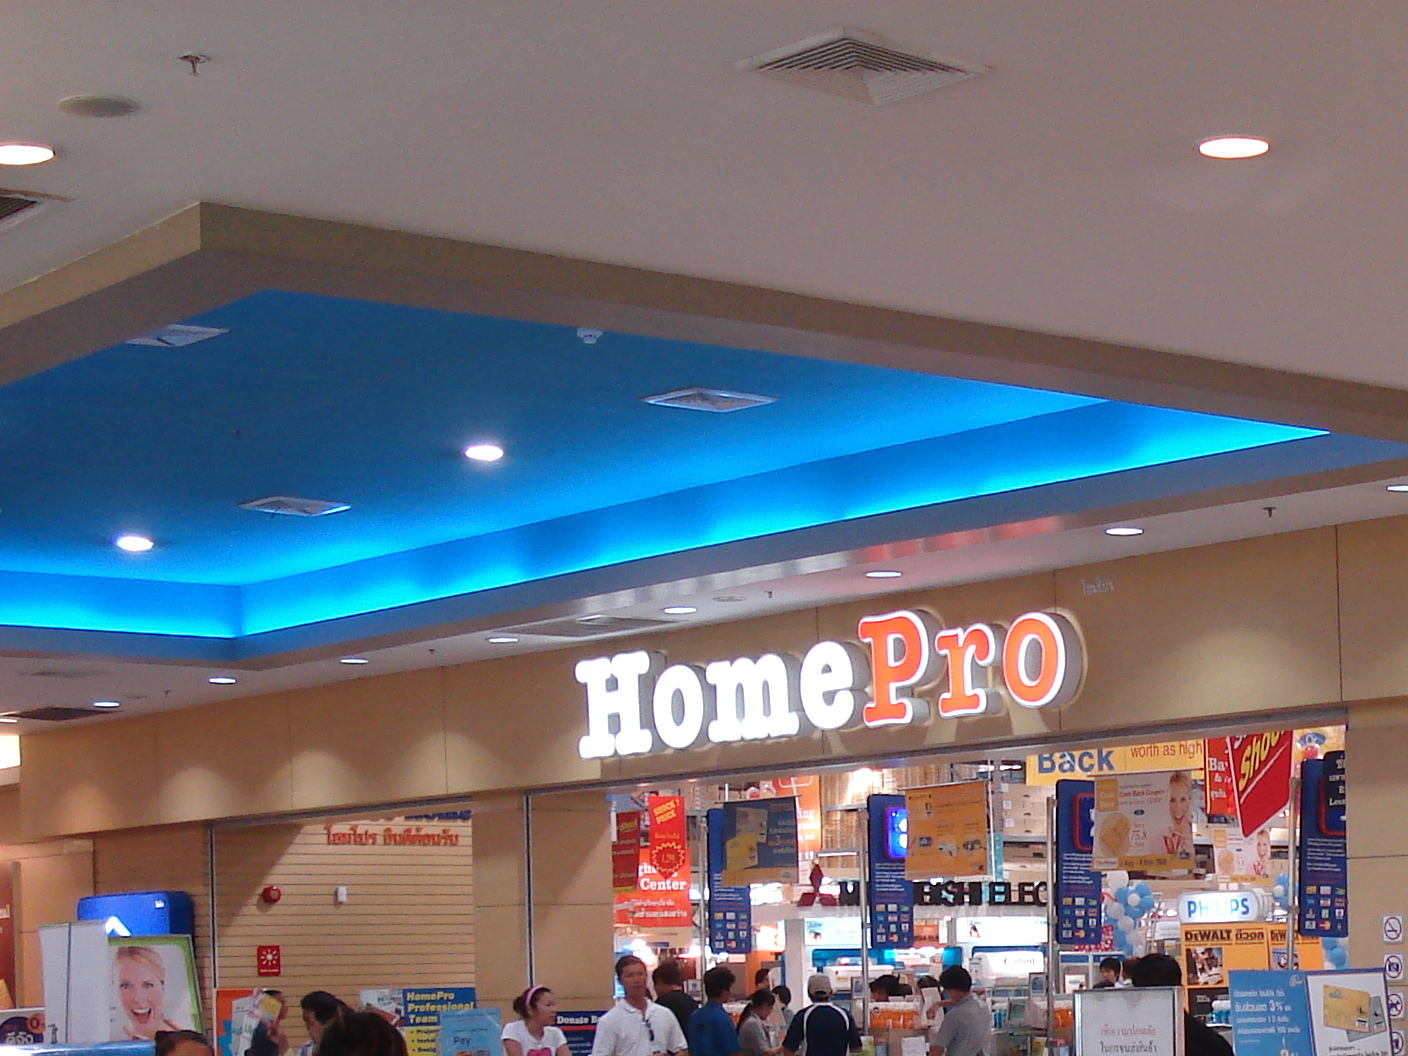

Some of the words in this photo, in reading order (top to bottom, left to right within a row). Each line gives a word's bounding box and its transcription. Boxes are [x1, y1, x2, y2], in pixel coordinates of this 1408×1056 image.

[575, 611, 1066, 759] HomePro
[1038, 749, 1115, 774] Back
[1131, 744, 1159, 758] worth
[1163, 744, 1175, 757] as
[640, 878, 687, 891] Center
[989, 880, 1048, 905] ELEC
[1187, 898, 1250, 918] PHILIPS
[407, 992, 455, 1001] HomePro
[408, 1002, 474, 1013] Professional
[409, 1014, 437, 1024] Team
[557, 1016, 589, 1026] Donate
